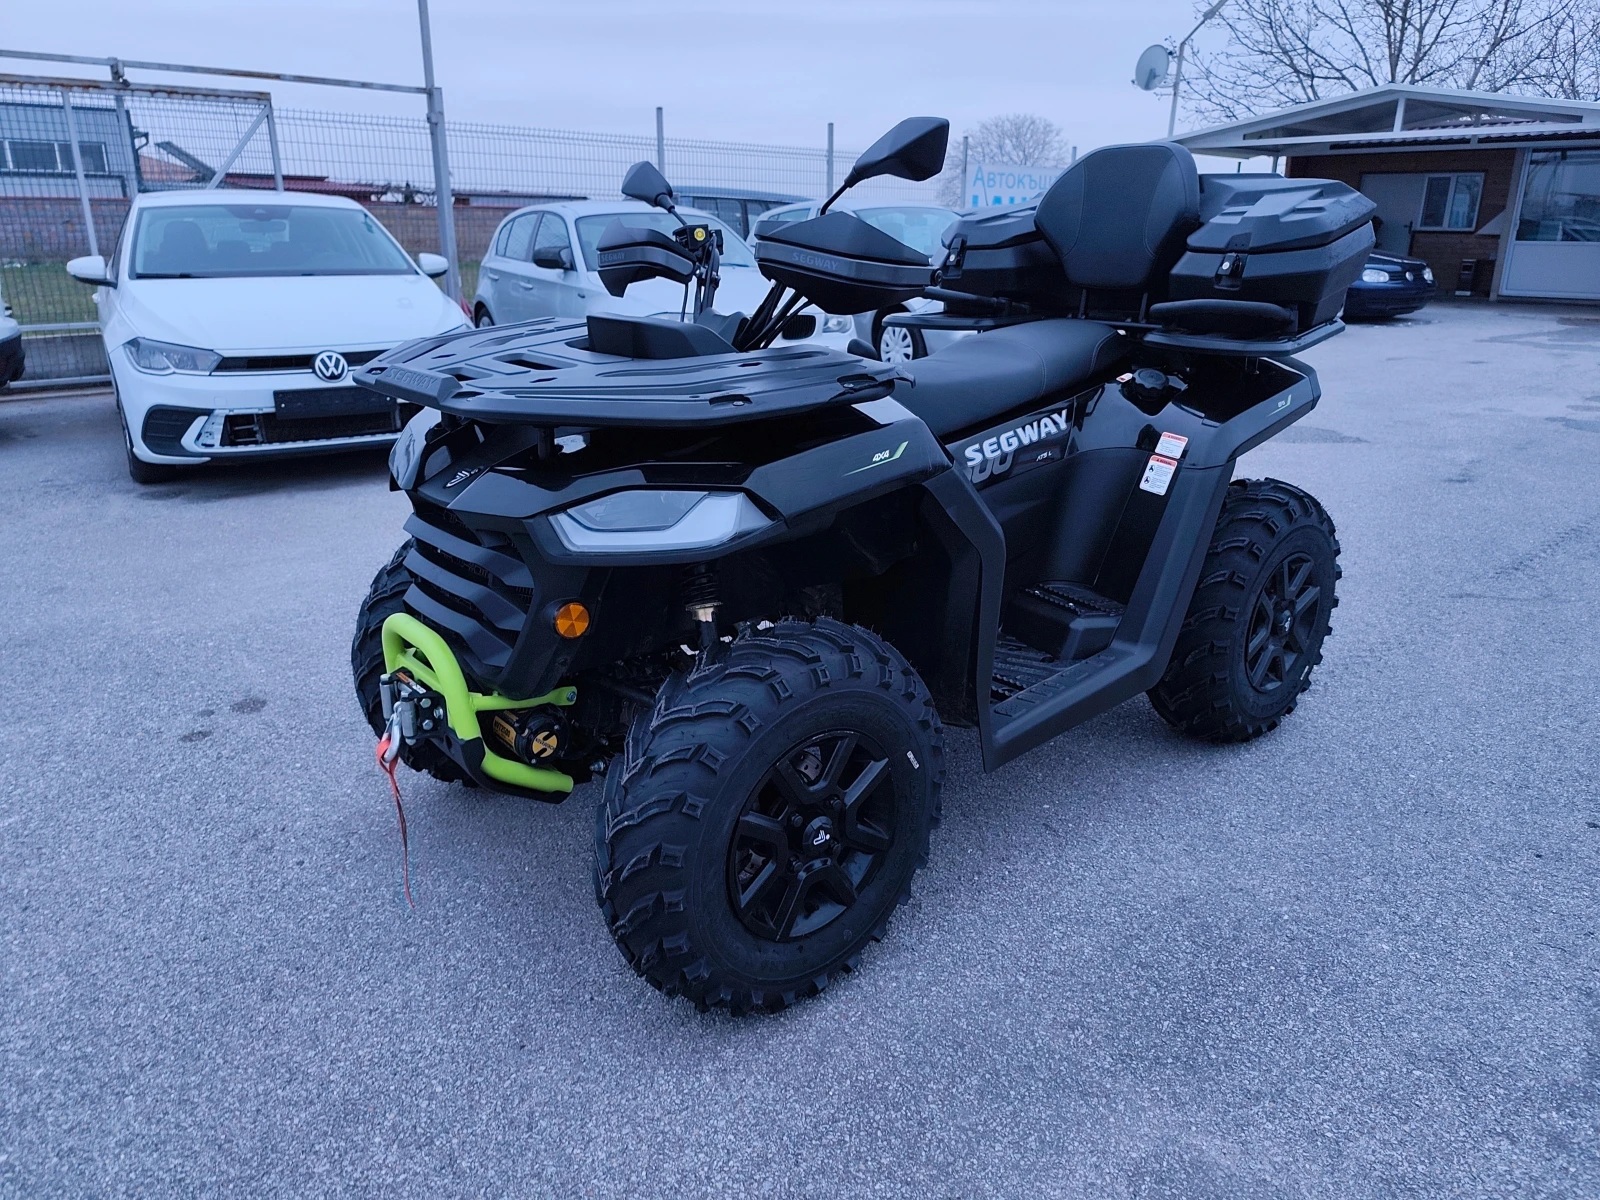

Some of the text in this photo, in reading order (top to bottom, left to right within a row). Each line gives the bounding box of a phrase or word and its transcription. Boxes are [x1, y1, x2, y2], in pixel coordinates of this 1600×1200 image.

[972, 165, 1058, 190] Автокъщ
[600, 251, 625, 262] SEGWAY
[791, 251, 838, 271] SEGWAY
[317, 353, 346, 381] VW
[385, 367, 438, 390] SEGWAY
[965, 409, 1068, 467] SEGWAY
